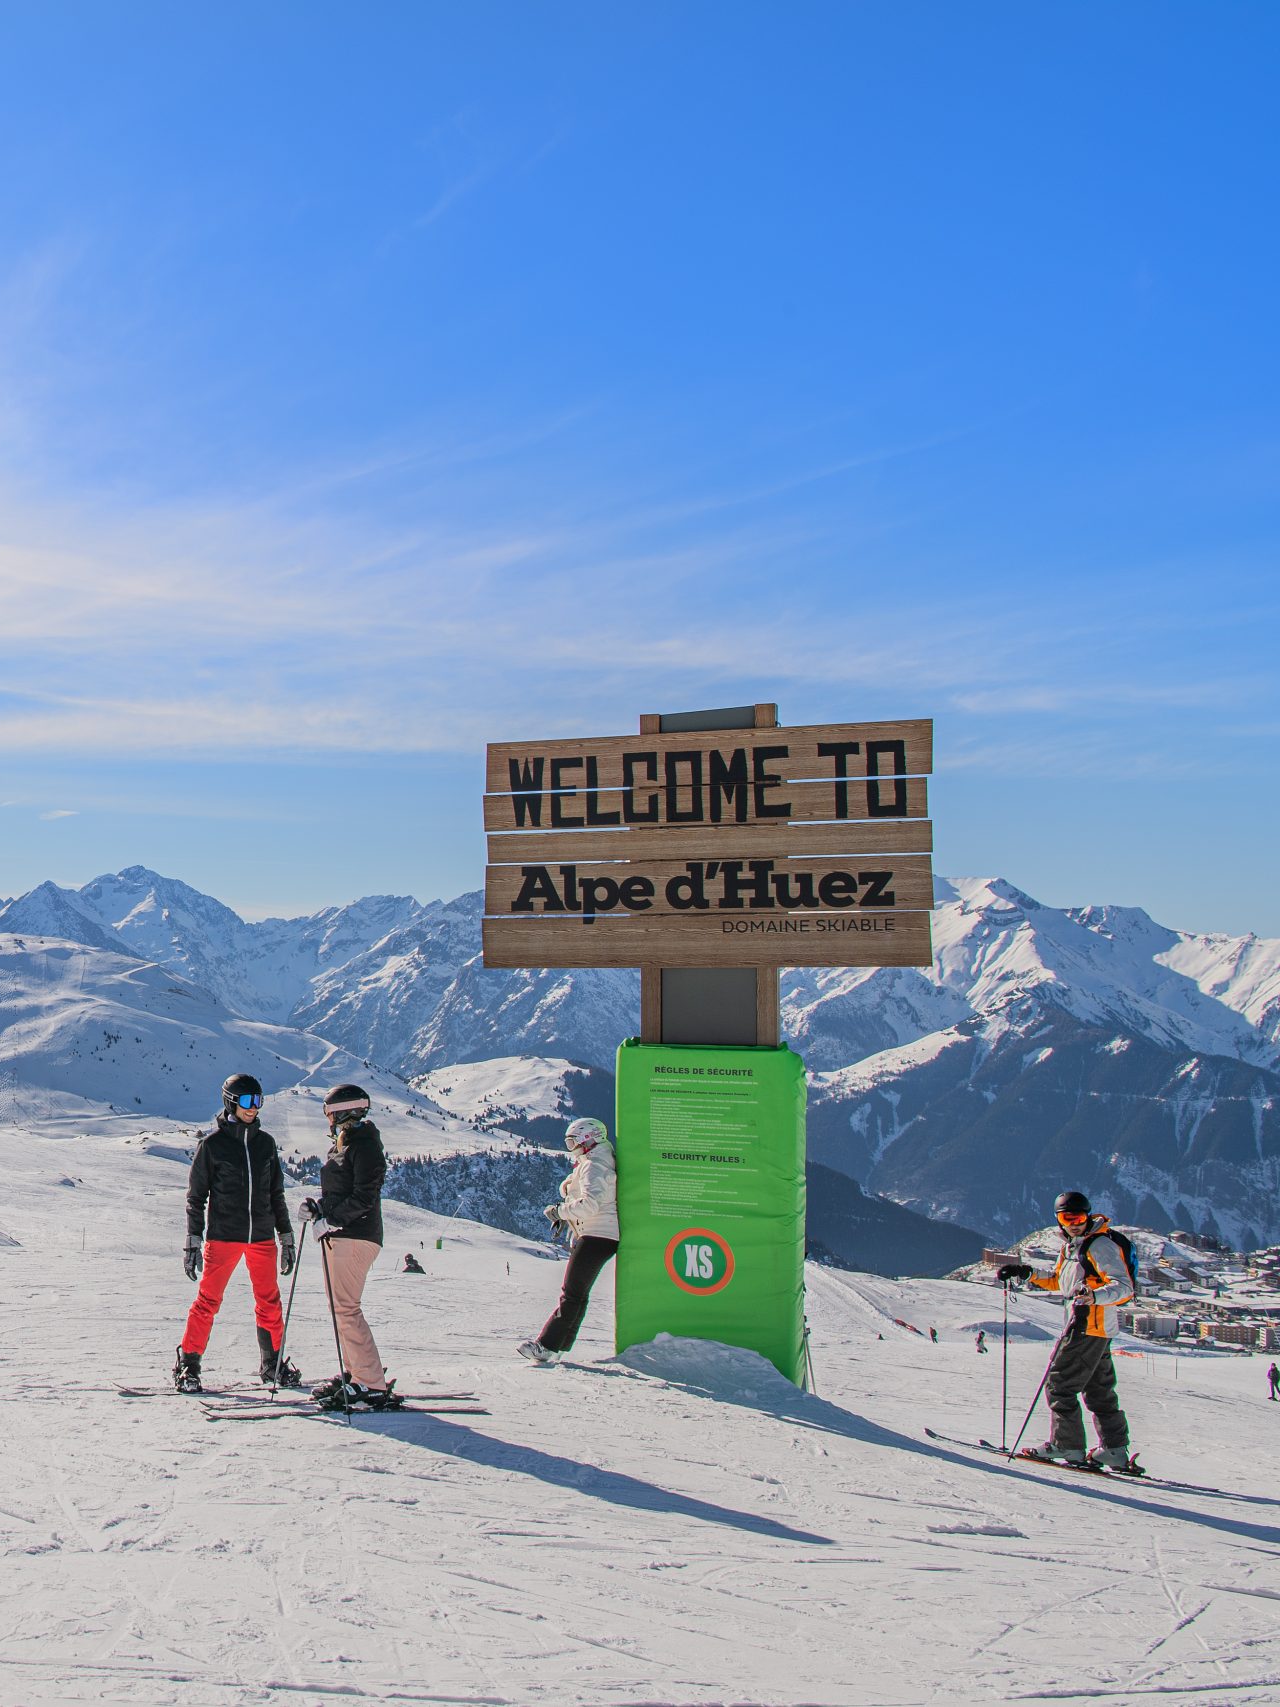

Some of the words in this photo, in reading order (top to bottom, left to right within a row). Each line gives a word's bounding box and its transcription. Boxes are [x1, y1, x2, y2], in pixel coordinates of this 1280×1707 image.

[508, 745, 792, 828] WELCOME
[817, 739, 907, 818] TO
[511, 864, 655, 924] Alpe
[665, 859, 896, 909] d'Huez
[722, 919, 810, 933] DOMAINE
[816, 917, 895, 932] SKIABLE
[692, 1067, 705, 1075] DE
[707, 1068, 753, 1076] SÉCURITÉ
[662, 1152, 707, 1161] SECURITY
[710, 1155, 740, 1163] RULES
[684, 1244, 713, 1279] XS
